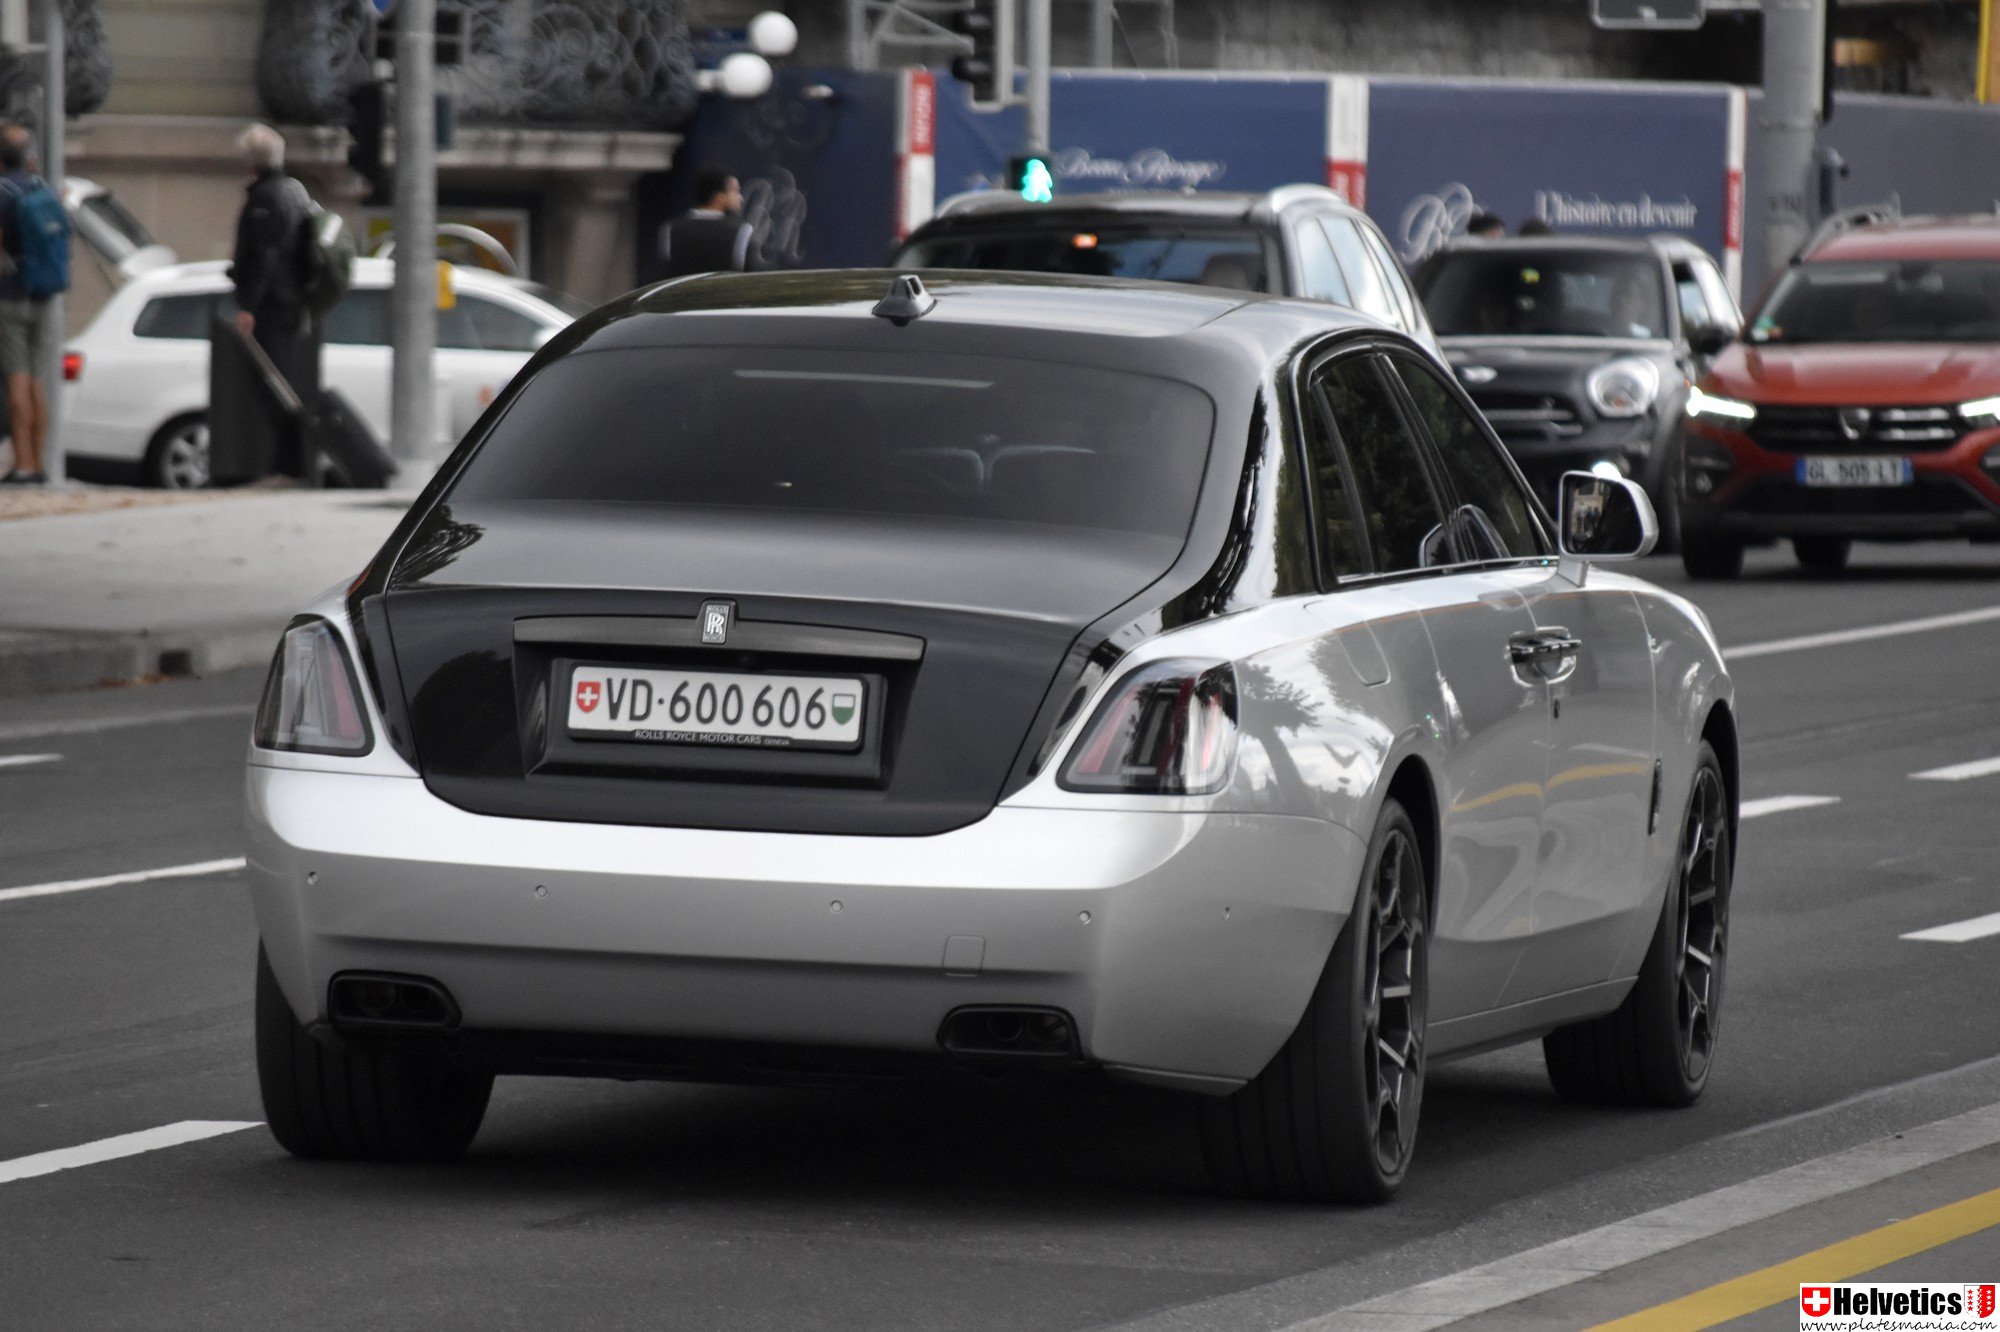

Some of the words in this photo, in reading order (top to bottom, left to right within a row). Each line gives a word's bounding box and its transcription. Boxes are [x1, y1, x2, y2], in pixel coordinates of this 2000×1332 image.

[635, 730, 664, 740] ROLLS
[666, 731, 697, 742] ROYCE
[700, 733, 735, 743] MOTOR
[737, 734, 762, 745] CARS
